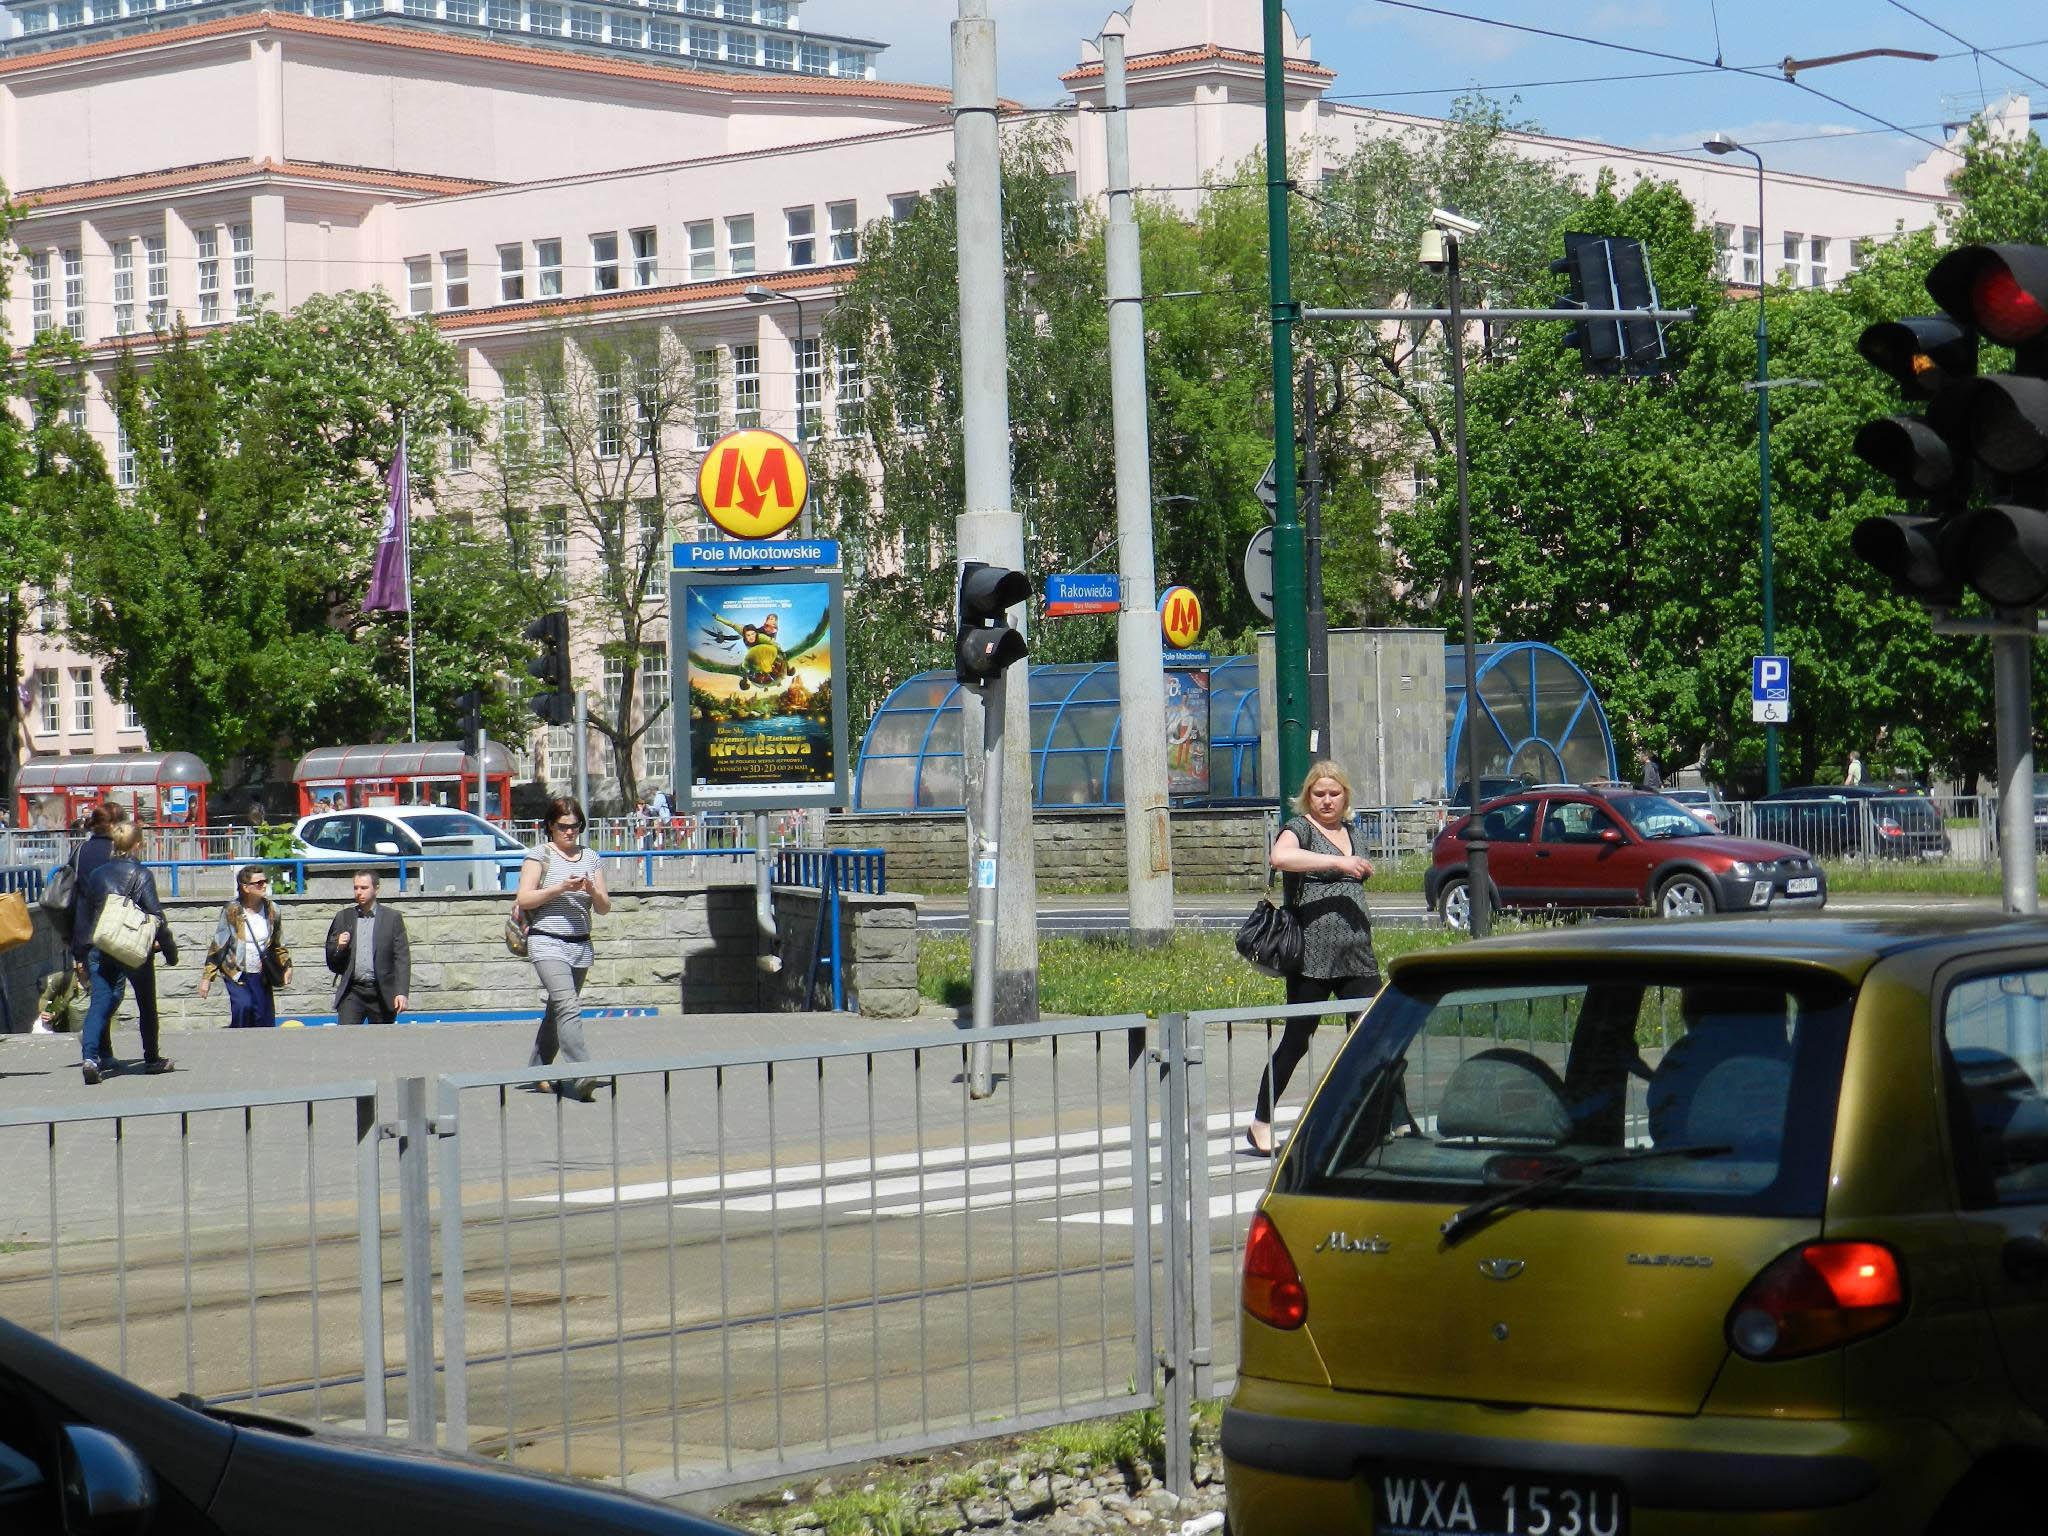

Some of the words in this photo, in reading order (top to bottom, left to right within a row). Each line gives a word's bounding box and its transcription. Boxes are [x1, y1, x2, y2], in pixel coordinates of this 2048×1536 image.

[692, 547, 724, 561] Pole
[729, 545, 821, 560] Mokotowskie
[1060, 584, 1112, 598] Rakowiecka
[1761, 661, 1781, 688] P
[710, 742, 812, 757] Królestwa
[750, 764, 761, 773] 3D
[764, 764, 777, 773] 2D
[1627, 1253, 1713, 1266] DAEWOO
[1384, 1477, 1477, 1531] WXA
[1502, 1484, 1619, 1536] 153U
